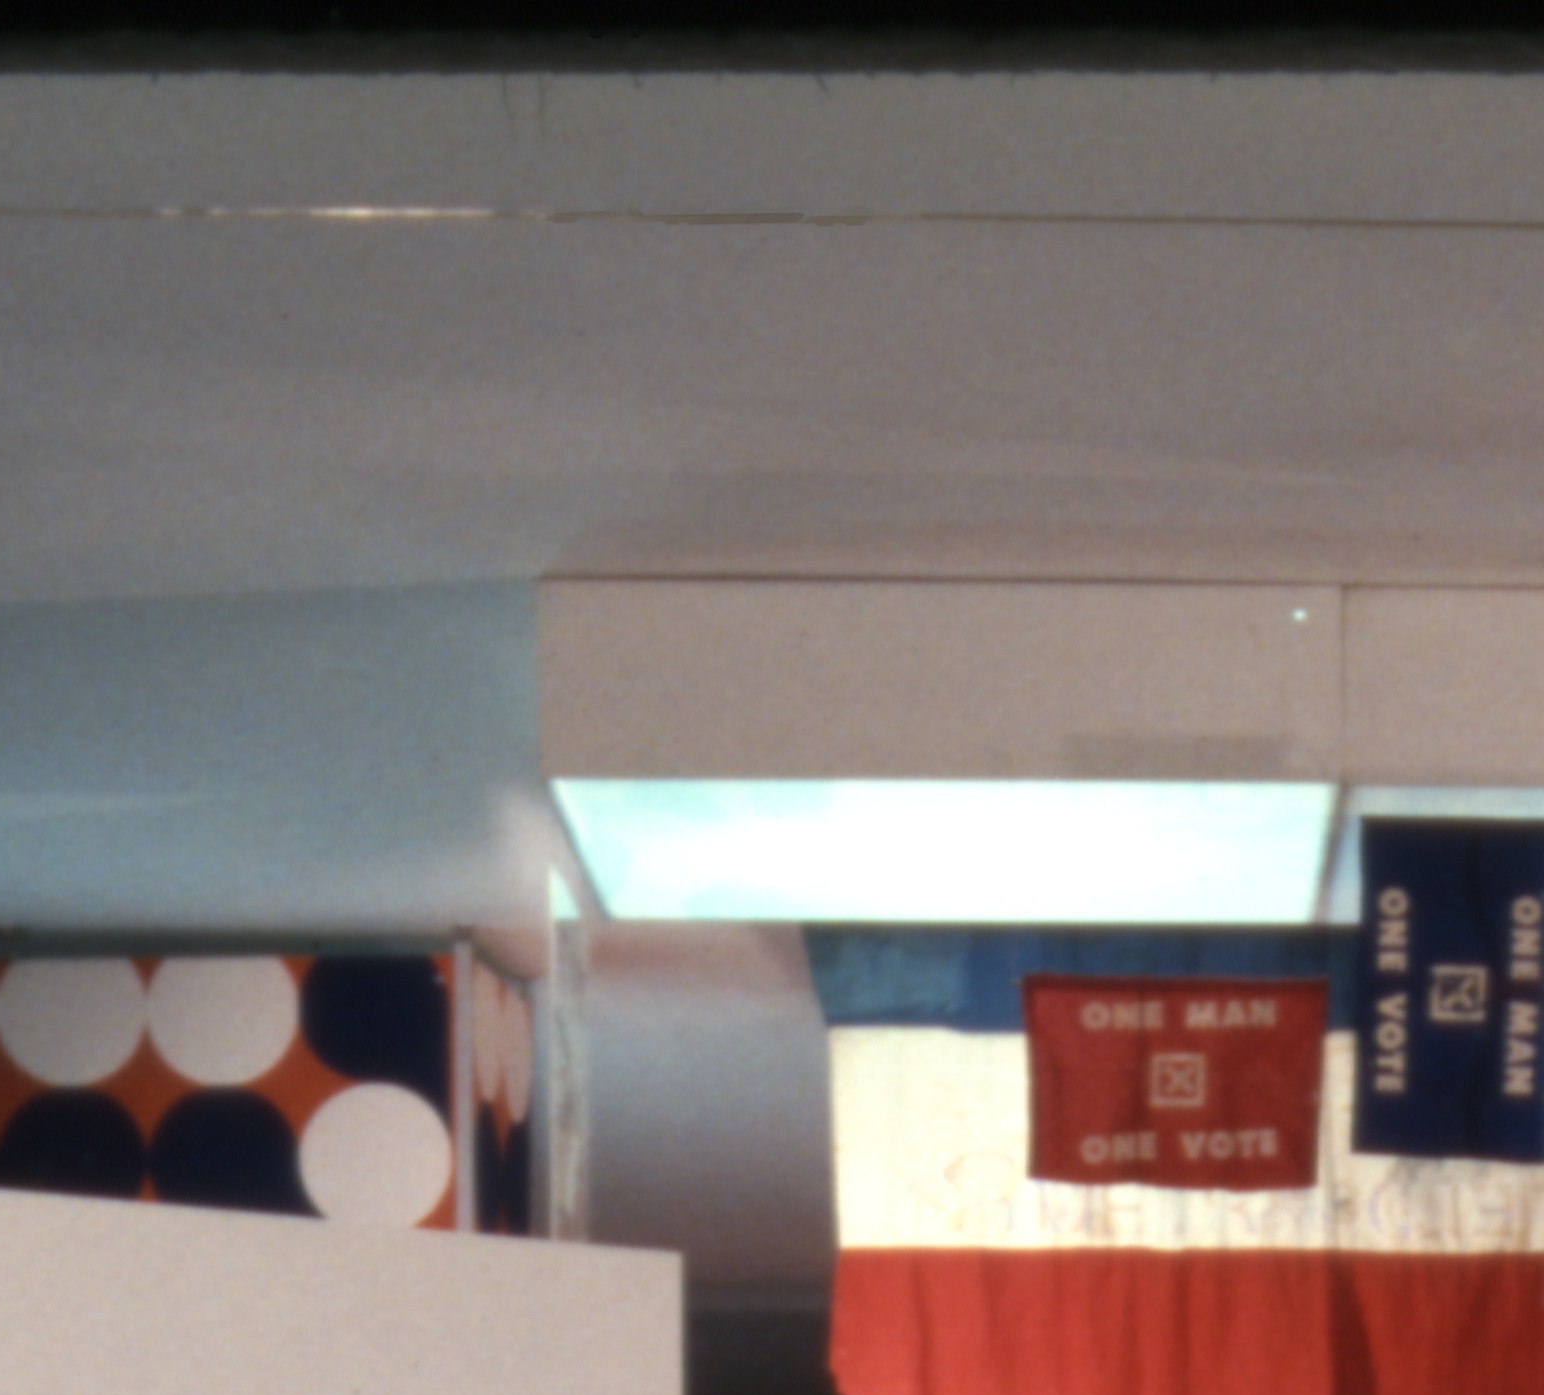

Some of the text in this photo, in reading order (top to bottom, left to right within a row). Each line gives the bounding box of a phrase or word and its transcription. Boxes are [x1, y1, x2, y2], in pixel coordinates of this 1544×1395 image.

[1080, 998, 1278, 1032] ONE MAN
[1375, 887, 1408, 1094] ONE VOTE
[1503, 896, 1541, 1096] ONE MAN
[1079, 1127, 1279, 1165] ONE VOTE
